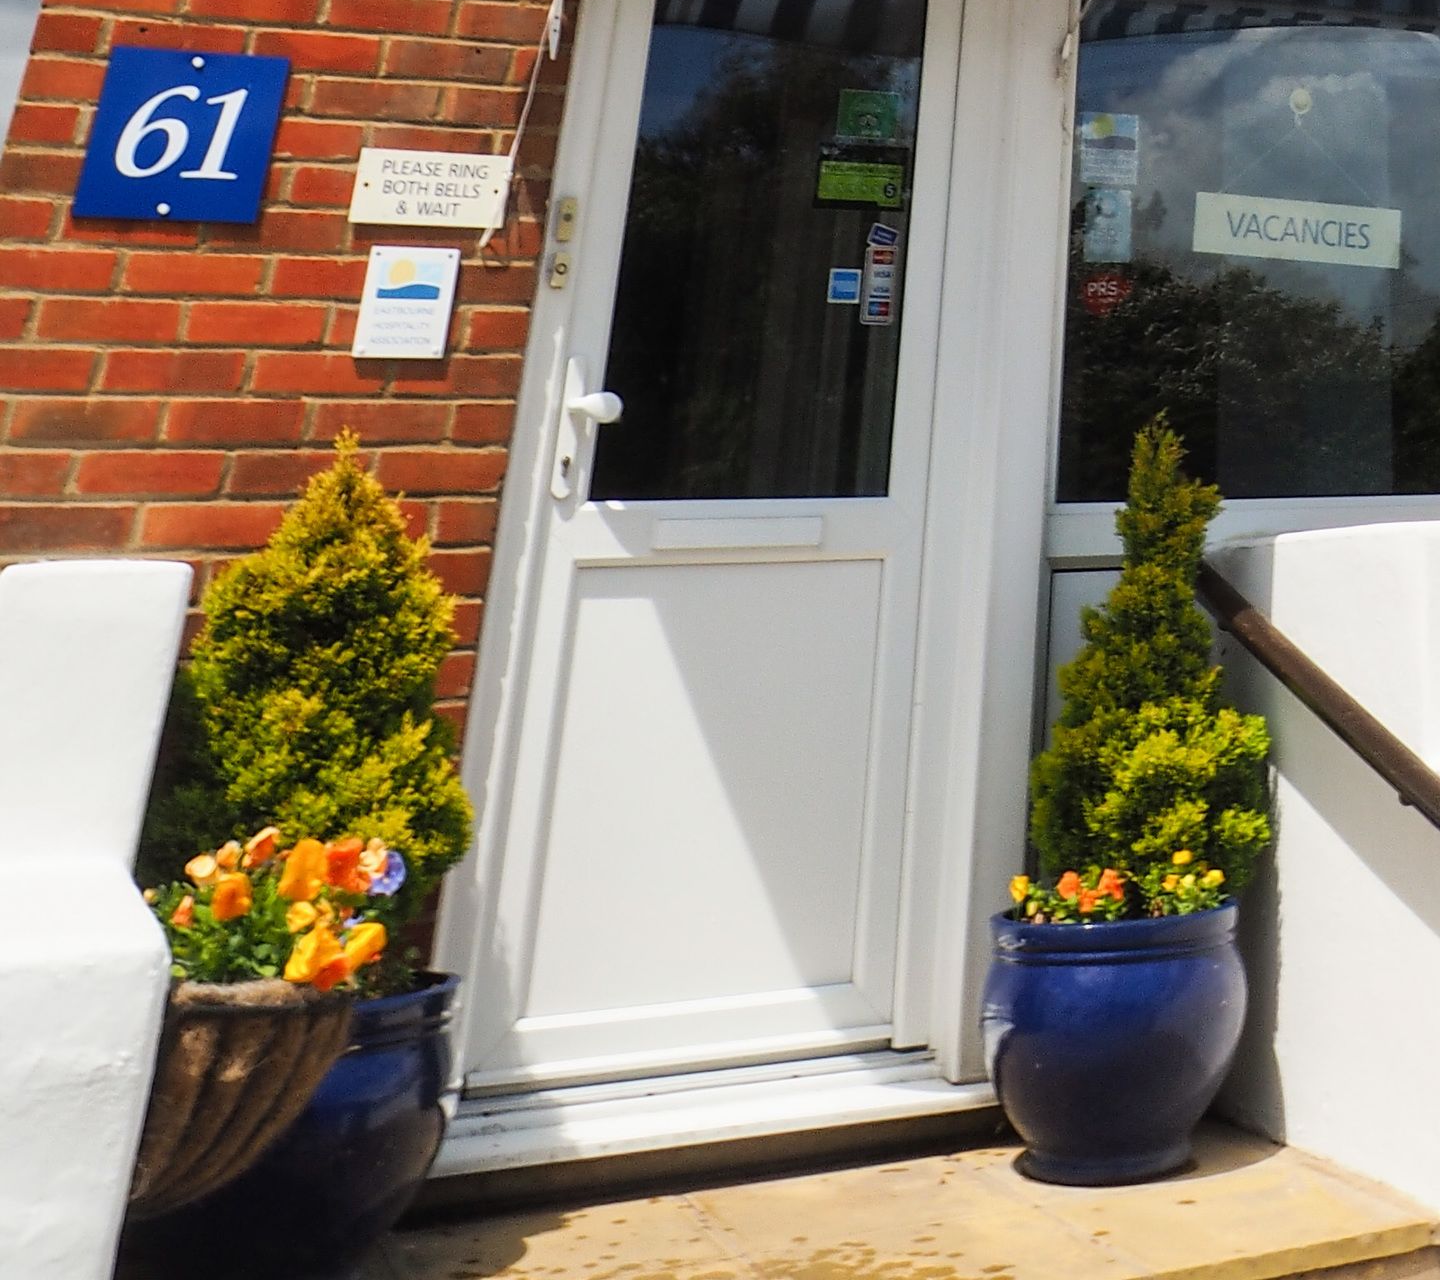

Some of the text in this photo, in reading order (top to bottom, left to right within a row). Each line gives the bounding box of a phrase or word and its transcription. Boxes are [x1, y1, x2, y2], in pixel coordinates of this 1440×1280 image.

[114, 84, 249, 182] 61
[382, 159, 490, 180] PLEASE RING
[382, 179, 481, 199] BOTH BELLS
[395, 199, 462, 217] & WAIT
[1226, 210, 1371, 250] VACANCIES
[1087, 280, 1118, 297] PRS
